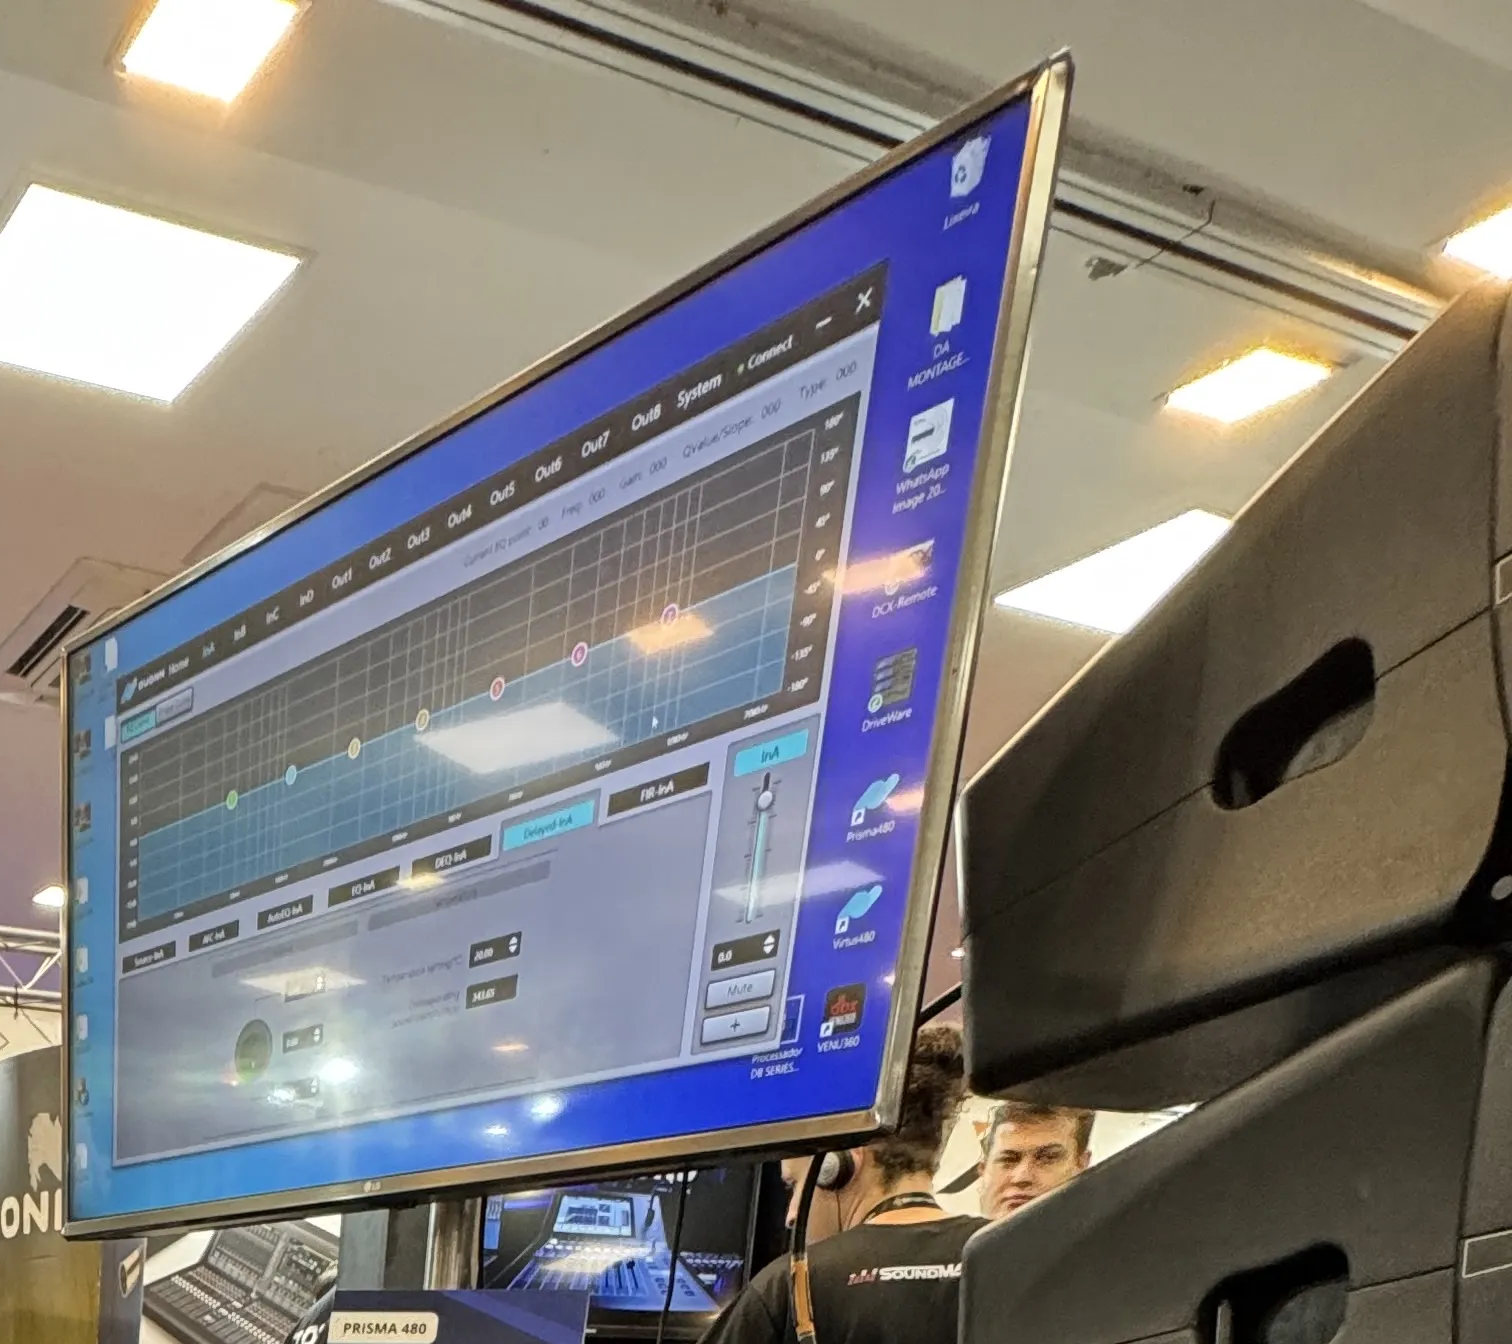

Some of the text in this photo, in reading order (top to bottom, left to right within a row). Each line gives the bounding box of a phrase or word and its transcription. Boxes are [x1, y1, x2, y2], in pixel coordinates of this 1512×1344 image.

[747, 334, 793, 370] Connect
[934, 340, 950, 358] DA
[677, 373, 722, 410] System
[631, 403, 661, 431] Out8
[581, 429, 611, 458] Out7
[535, 456, 562, 482] Out6
[896, 463, 949, 494] WhatsApp
[490, 480, 515, 505] Out5
[892, 492, 926, 514] Image
[447, 503, 472, 528] Out4
[407, 527, 430, 549] Out3
[369, 548, 392, 570] Out2
[332, 568, 353, 589] Out1
[871, 586, 939, 619] DCX-Remote
[861, 706, 914, 732] DriveWare
[760, 746, 780, 763] InA
[640, 778, 675, 802] FIR-InA
[846, 820, 896, 843] Prisma480
[833, 930, 876, 950] Virtus480
[717, 950, 733, 963] 0.0
[726, 982, 754, 997] Mute
[817, 1035, 861, 1053] VENU360
[751, 1047, 804, 1064] Processador
[343, 1322, 428, 1335] PRISMA 480
